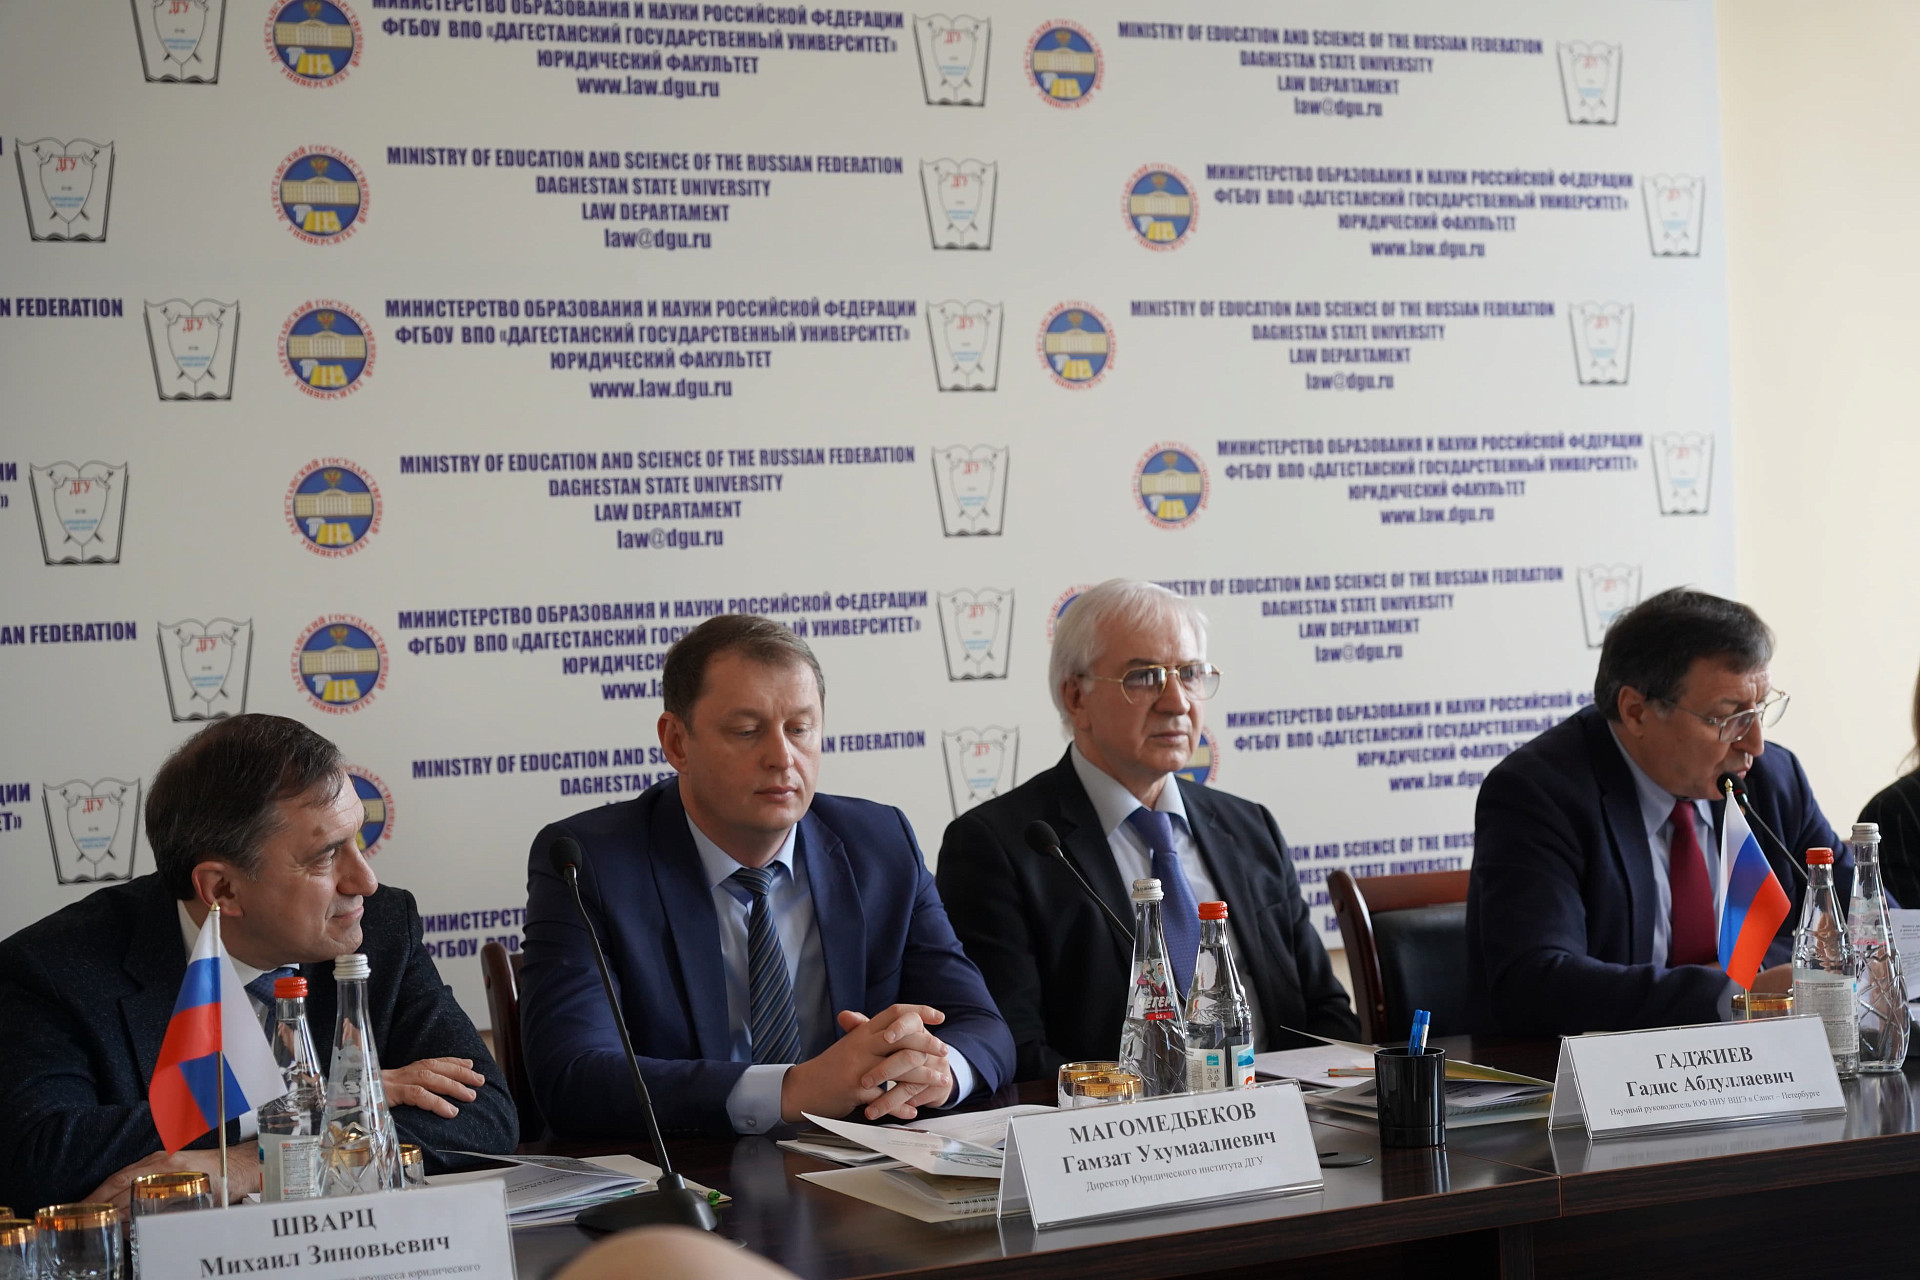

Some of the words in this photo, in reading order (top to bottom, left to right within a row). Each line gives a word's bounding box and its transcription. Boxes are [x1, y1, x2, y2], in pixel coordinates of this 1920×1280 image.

[509, 0, 630, 18] ОБРАЗОВАНИЯ
[633, 2, 644, 18] И
[647, 2, 699, 20] НАУКИ
[702, 4, 807, 24] РОССИЙСКОЙ
[810, 9, 904, 29] ФЕДЕРАЦИИ
[381, 17, 440, 36] ФГБОУ
[447, 19, 482, 38] ВПО
[485, 21, 622, 43] «ДАГЕСТАНСКИЙ
[624, 27, 784, 49] ГОСУДАРСТВЕННЫЙ
[786, 33, 897, 53] УНИВЕРСИТЕТ»
[536, 49, 662, 70] ЮРИДИЧЕСКИЙ
[665, 53, 757, 73] ФАКУЛЬТЕТ
[576, 76, 720, 98] www.law.dgu.ru
[386, 146, 466, 165] MINISTRY
[471, 148, 490, 166] OF
[494, 149, 584, 168] EDUCATION
[587, 151, 620, 168] AND
[624, 151, 689, 170] SCIENCE
[692, 153, 710, 170] OF
[715, 153, 742, 170] THE
[745, 154, 813, 172] RUSSIAN
[815, 156, 903, 173] FEDERATION
[535, 176, 628, 194] DAGHESTAN
[631, 177, 677, 195] STATE
[680, 178, 770, 196] UNIVERSITY
[581, 202, 616, 219] LAW
[619, 203, 728, 221] DEPARTAMENT
[603, 228, 711, 250] law@dgu.ru
[15, 297, 123, 317] FEDERATION
[384, 299, 520, 317] МИНИСТЕРСТВО
[523, 300, 643, 317] ОБРАЗОВАНИЯ
[646, 300, 657, 316] И
[660, 300, 712, 316] НАУКИ
[715, 299, 820, 316] РОССИЙСКОЙ
[823, 300, 916, 318] ФЕДЕРАЦИИ
[394, 325, 453, 343] ФГБОУ
[460, 326, 495, 343] ВПО
[499, 325, 634, 343] «ДАГЕСТАНСКИЙ
[638, 325, 796, 342] ГОСУДАРСТВЕННЫЙ
[799, 325, 909, 341] УНИВЕРСИТЕТ»
[549, 351, 675, 369] ЮРИДИЧЕСКИЙ
[678, 350, 770, 368] ФАКУЛЬТЕТ
[589, 378, 732, 399] www.law.dgu.ru
[399, 454, 479, 473] MINISTRY
[484, 454, 503, 472] OF
[507, 452, 597, 471] EDUCATION
[600, 452, 633, 469] AND
[636, 450, 701, 468] SCIENCE
[705, 450, 723, 467] OF
[728, 449, 755, 466] THE
[758, 448, 825, 465] RUSSIAN
[828, 446, 915, 464] FEDERATION
[548, 477, 641, 496] DAGHESTAN
[644, 476, 689, 494] STATE
[693, 474, 782, 492] UNIVERSITY
[593, 503, 629, 521] LAW
[631, 501, 741, 519] DEPARTAMENT
[616, 528, 723, 549] law@dgu.ru
[1209, 579, 1223, 595] OF
[1228, 576, 1300, 594] EDUCATION
[1304, 575, 1330, 591] AND
[1334, 573, 1386, 590] SCIENCE
[1390, 572, 1404, 588] OF
[1409, 571, 1430, 586] THE
[1434, 569, 1488, 585] RUSSIAN
[1492, 566, 1562, 583] FEDERATION
[397, 606, 532, 629] МИНИСТЕРСТВО
[536, 601, 655, 623] ОБРАЗОВАНИЯ
[658, 601, 669, 618] И
[673, 599, 724, 617] НАУКИ
[727, 594, 831, 617] РОССИЙСКОЙ
[835, 590, 927, 611] ФЕДЕРАЦИИ
[1260, 598, 1337, 616] DAGHESTAN
[1340, 596, 1376, 613] STATE
[1379, 593, 1453, 610] UNIVERSITY
[29, 621, 136, 643] FEDERATION
[407, 635, 466, 654] ФГБОУ
[473, 633, 507, 652] ВПО
[512, 628, 647, 650] «ДАГЕСТАНСКИЙ
[811, 616, 921, 636] УНИВЕРСИТЕТ»
[1298, 623, 1326, 638] LAW
[1329, 618, 1419, 636] DEPARTAMENT
[1313, 643, 1403, 662] law@dgu.ru
[411, 756, 491, 778] MINISTRY
[496, 755, 515, 773] OF
[519, 750, 609, 772] EDUCATION
[612, 748, 645, 766] AND
[838, 731, 925, 751] FEDERATION
[1655, 1046, 1753, 1071] ГАДЖИЕВ
[1625, 1080, 1679, 1098] Гадис
[1684, 1071, 1795, 1094] Абдуллаевич
[1609, 1105, 1643, 1116] Научный
[1644, 1101, 1692, 1115] руководитель
[1069, 1102, 1257, 1144] МАГОМЕДБЕКОВ
[1062, 1150, 1132, 1174] Гамзат
[1136, 1131, 1276, 1164] Ухумаалиевич
[1086, 1176, 1130, 1193] Директор
[1131, 1166, 1198, 1185] Юридического
[1199, 1160, 1244, 1176] института
[1244, 1155, 1264, 1170] ДГУ
[271, 1208, 377, 1238] ШВАРЦ
[200, 1250, 301, 1279] Михаил
[306, 1235, 451, 1266] Зиновьевич
[407, 1263, 481, 1280] юридического
